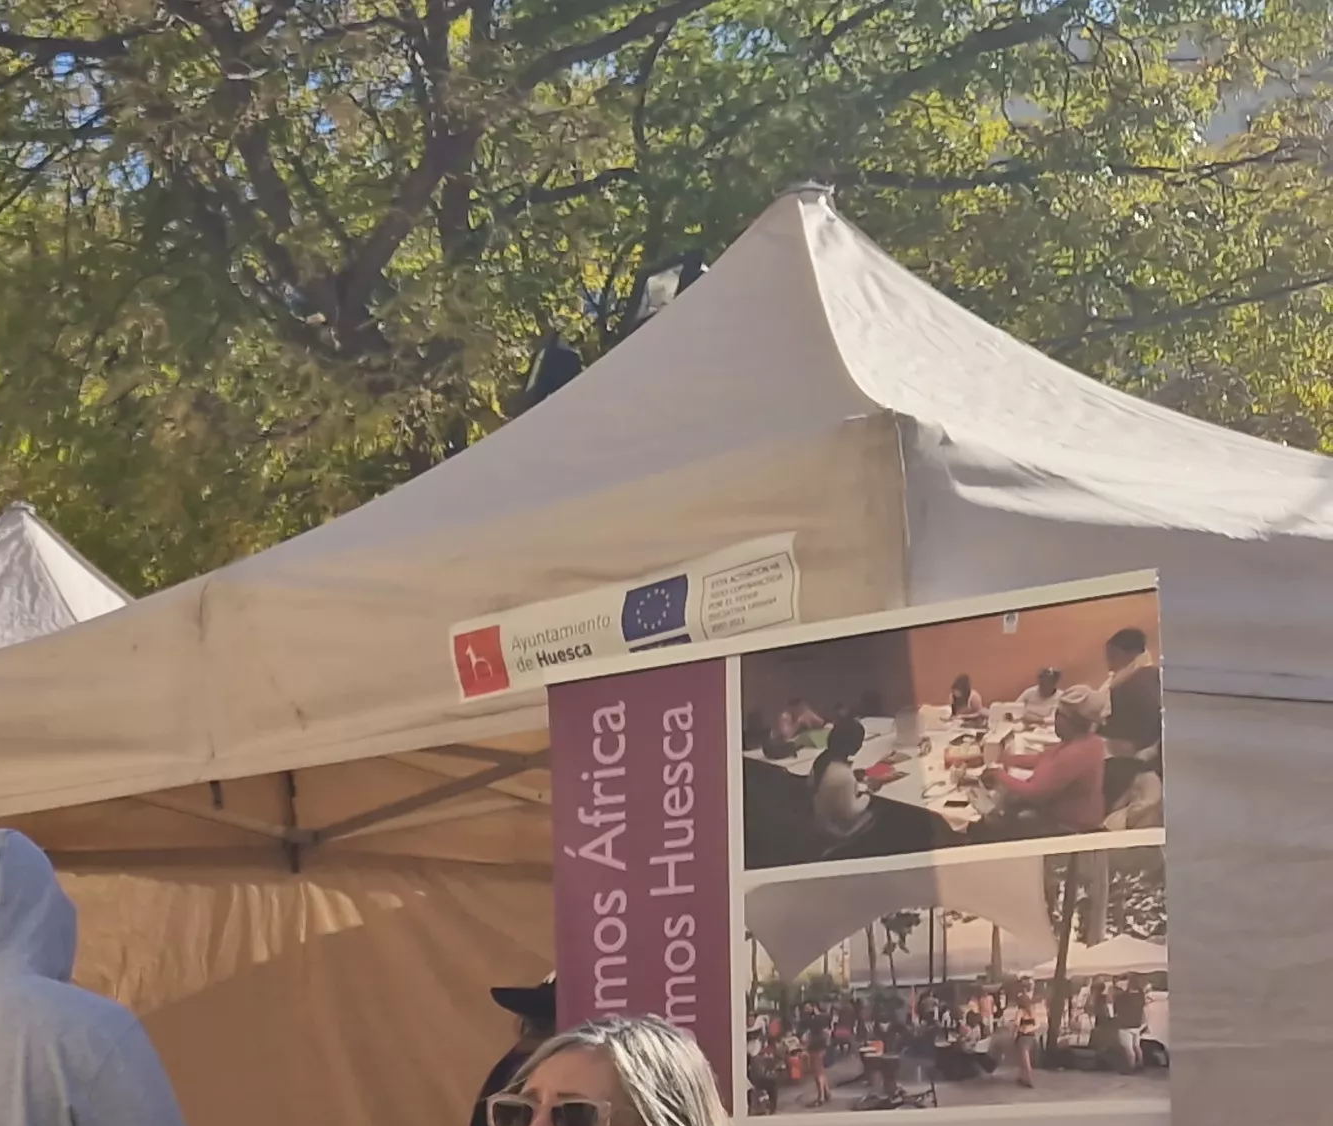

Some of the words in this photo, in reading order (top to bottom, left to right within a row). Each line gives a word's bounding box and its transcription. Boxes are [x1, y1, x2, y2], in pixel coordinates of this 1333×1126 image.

[511, 614, 610, 654] Ayuntamiento
[516, 656, 534, 672] de
[535, 643, 592, 668] Huesca
[564, 701, 627, 870] África
[649, 702, 694, 896] Huesca
[594, 889, 627, 1014] mos
[664, 914, 696, 1034] mos
